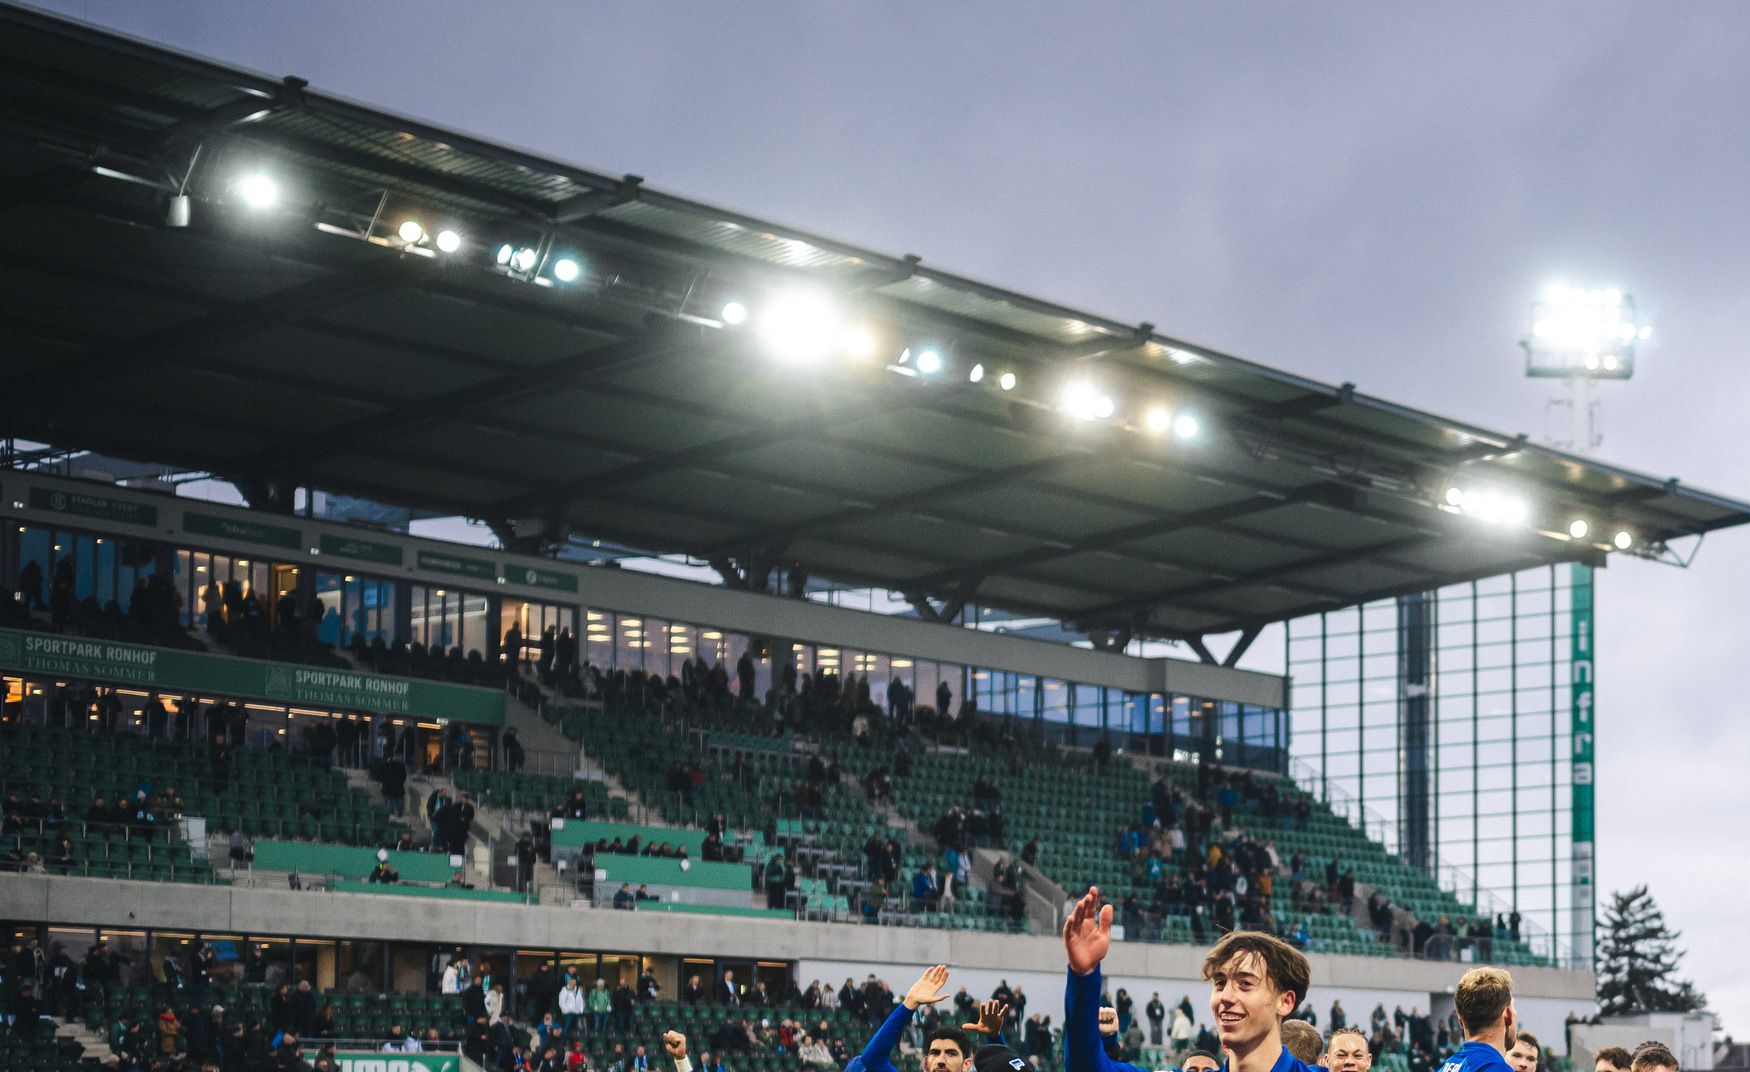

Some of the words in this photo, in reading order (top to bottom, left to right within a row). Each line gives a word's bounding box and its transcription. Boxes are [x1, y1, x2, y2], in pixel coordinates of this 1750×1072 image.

[26, 637, 101, 658] SPORTPARK
[106, 647, 156, 665] RONHOF
[26, 656, 90, 673] THOMAS
[94, 665, 156, 682] SOMMER
[296, 669, 361, 689] SPORTPARK
[366, 678, 410, 695] RONHOF
[296, 689, 350, 705] THOMAS
[354, 695, 408, 712] SOMMER
[1573, 620, 1592, 785] infra
